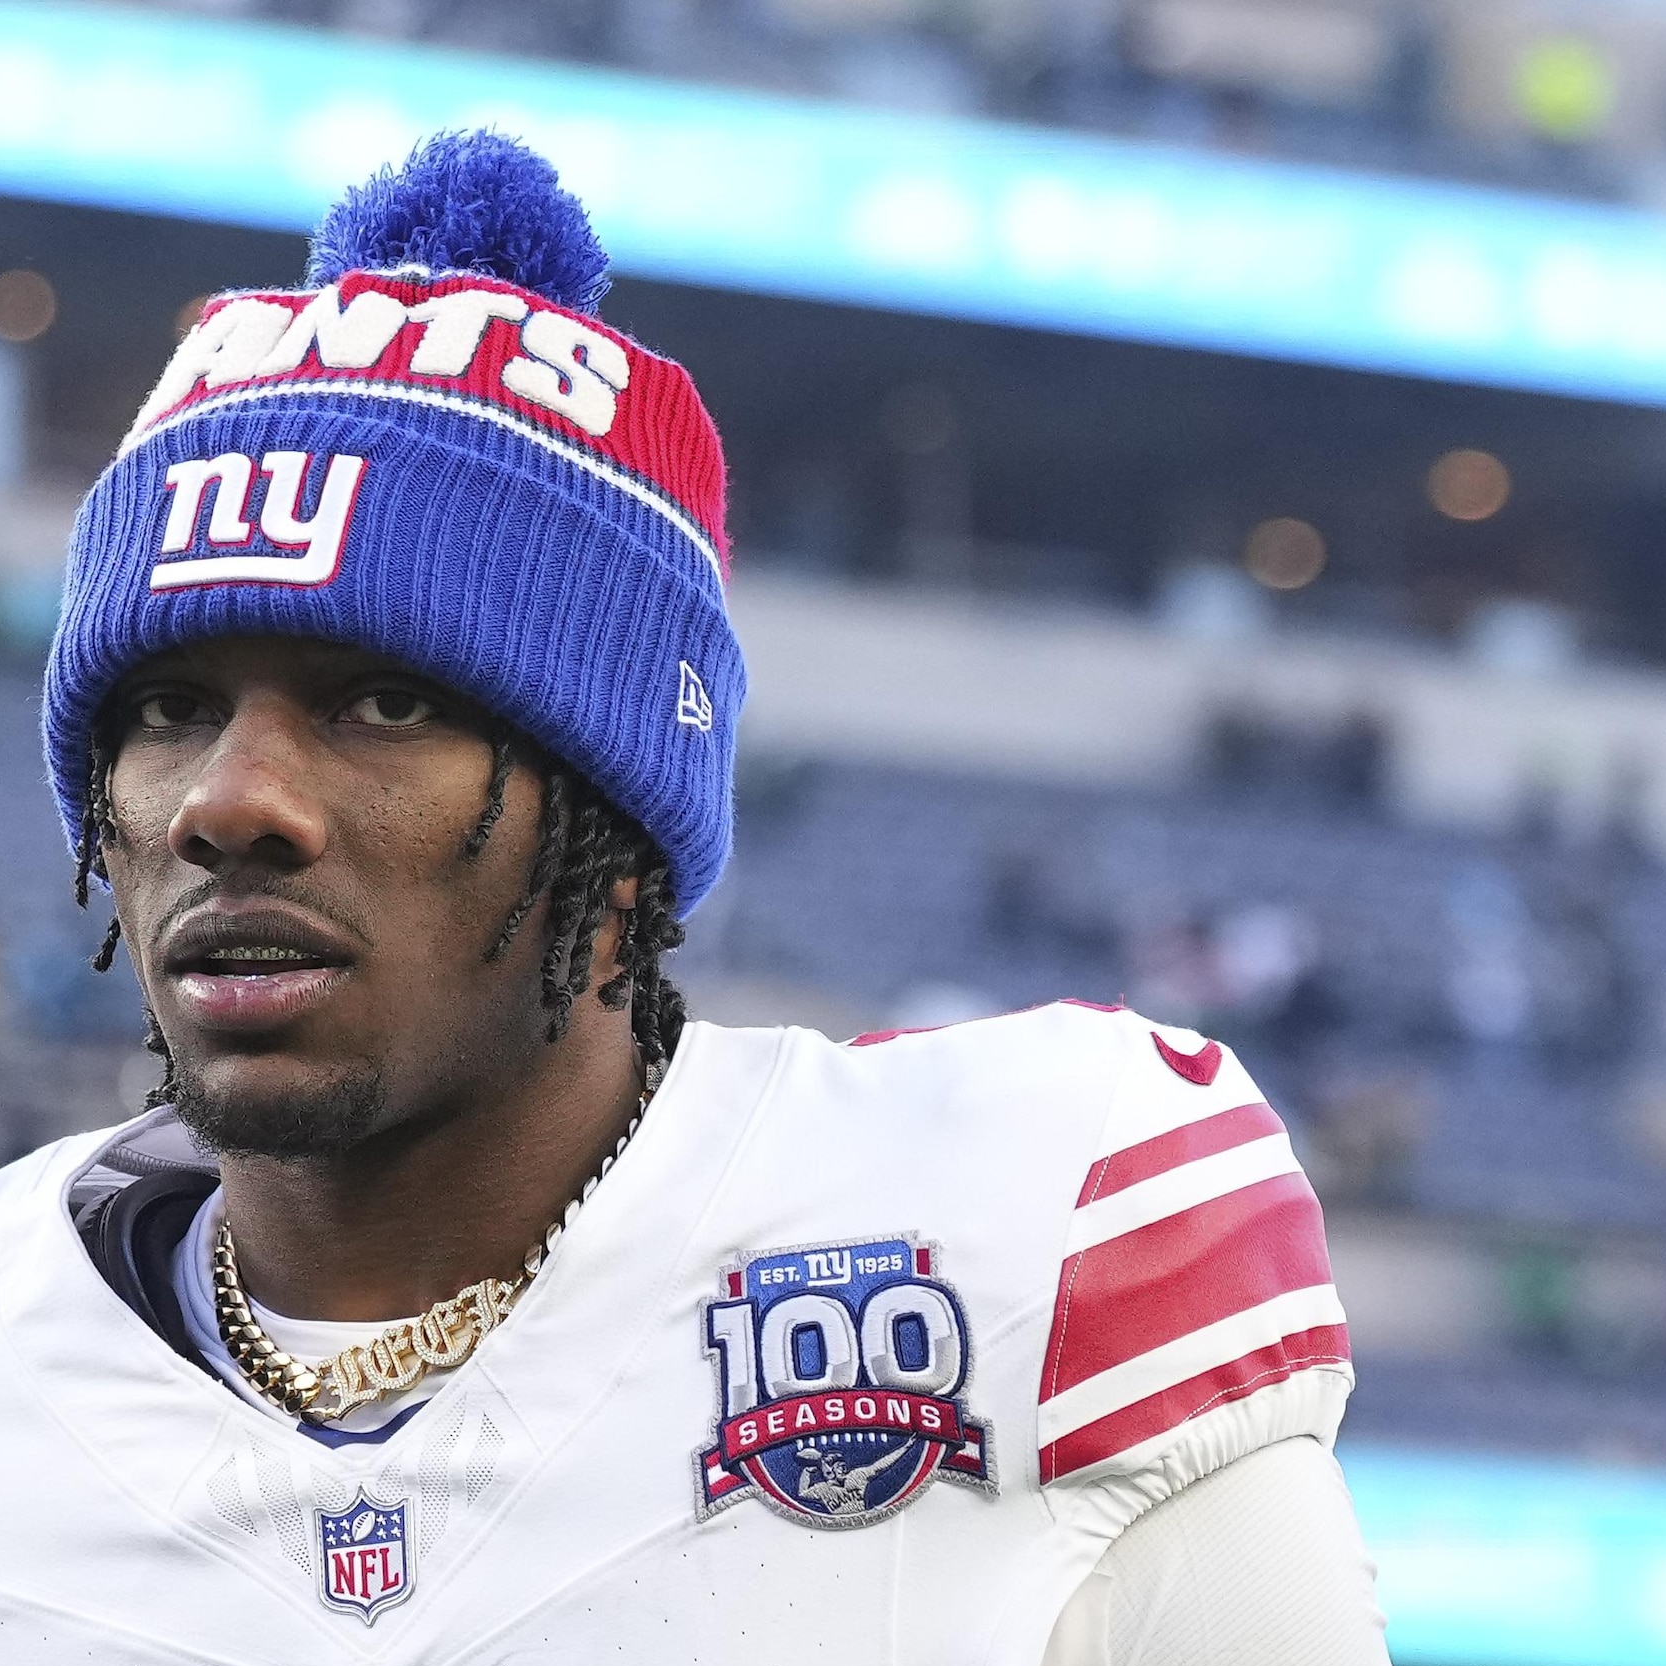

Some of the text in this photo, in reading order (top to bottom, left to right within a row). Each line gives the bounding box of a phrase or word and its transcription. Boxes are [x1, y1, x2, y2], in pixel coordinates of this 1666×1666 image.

[123, 284, 631, 445] ANTS
[759, 1265, 801, 1285] EST.
[855, 1253, 904, 1275] 1925
[709, 1281, 966, 1417] 100
[738, 1396, 941, 1446] SEASONS
[332, 1546, 400, 1599] NFL
